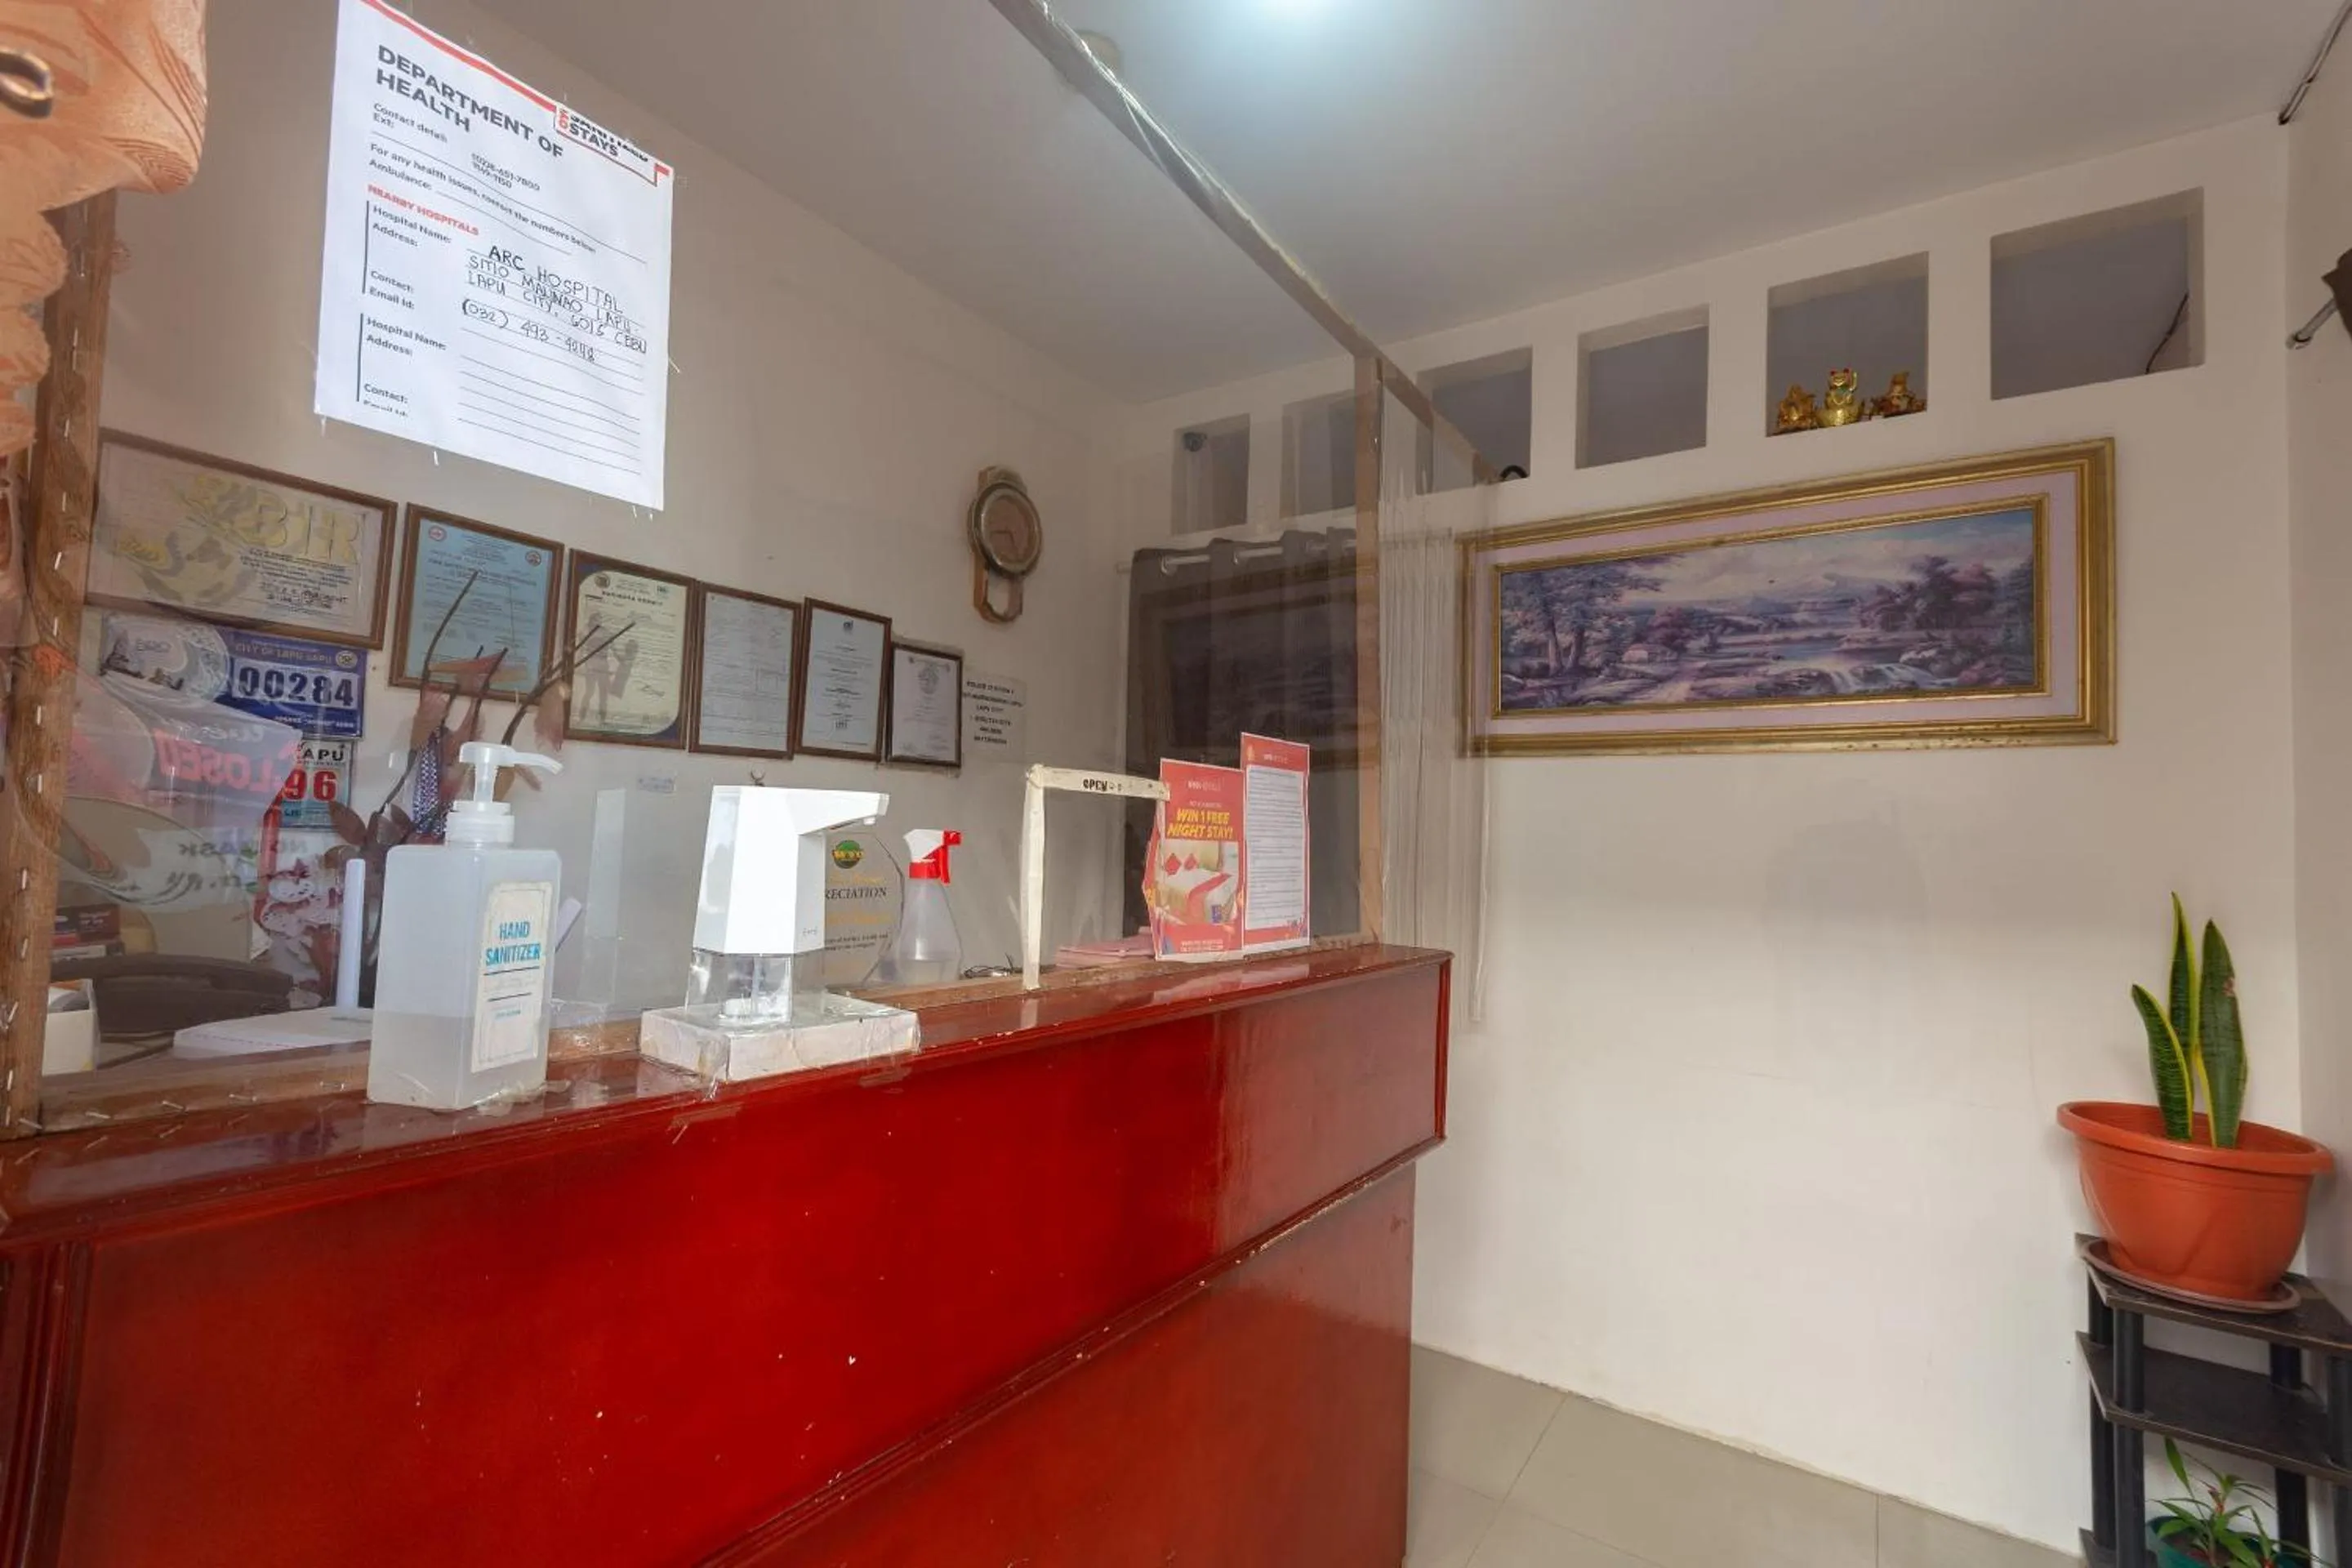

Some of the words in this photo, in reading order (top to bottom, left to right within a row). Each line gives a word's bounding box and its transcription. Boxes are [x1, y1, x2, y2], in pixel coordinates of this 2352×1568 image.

[376, 68, 470, 132] HEALTH
[378, 44, 533, 140] DEPARTMENT
[538, 135, 564, 158] OF
[373, 113, 394, 129] Ext:
[374, 102, 415, 127] Contact
[569, 123, 618, 156] STAYS
[371, 143, 389, 157] For
[391, 153, 412, 166] any
[413, 160, 446, 181] health
[514, 211, 529, 223] the
[531, 220, 569, 241] numbers
[368, 184, 415, 210] NEARBY
[416, 205, 479, 236] HOSPITALS
[373, 205, 417, 230] Hospital
[469, 255, 510, 278] SITIO
[469, 270, 506, 296] LAPU
[488, 245, 525, 270] ARC
[537, 265, 623, 314] HOSPITAL
[370, 286, 399, 304] Email
[462, 299, 509, 329] (032)
[368, 316, 413, 339] Hospital
[363, 383, 408, 403] Contact:
[238, 666, 354, 707] 00284
[303, 747, 345, 762] APU
[1176, 808, 1199, 822] WIN
[1207, 811, 1230, 824] FREE
[1167, 822, 1206, 838] NIGHT
[1207, 826, 1233, 840] STAY!
[826, 887, 887, 900] RECIATION
[499, 921, 530, 941] HAND
[485, 942, 541, 966] SANITIZER
